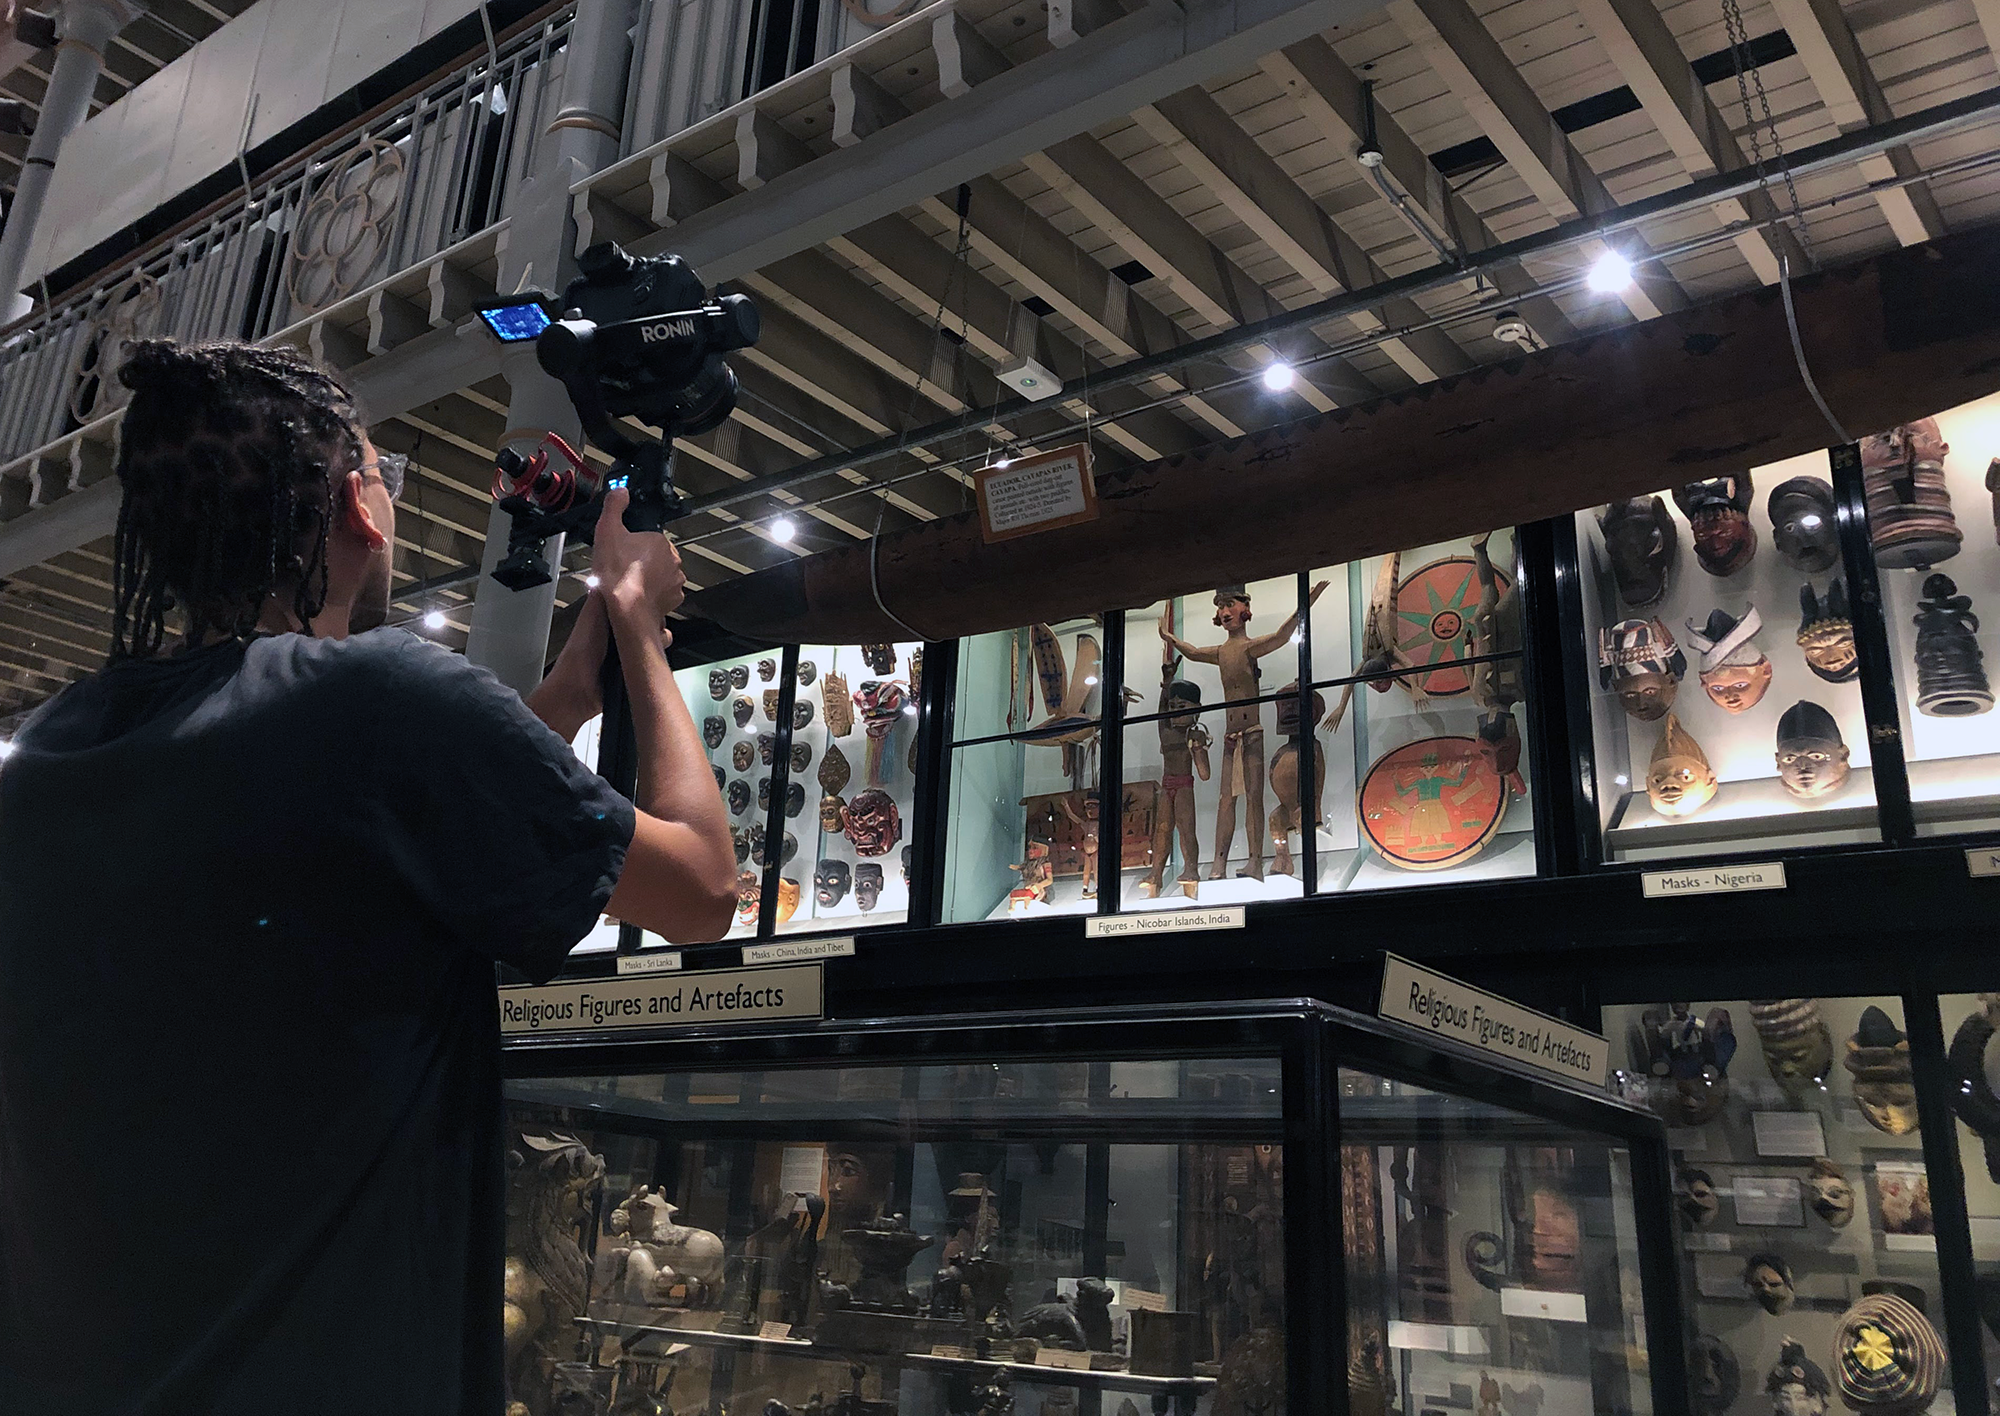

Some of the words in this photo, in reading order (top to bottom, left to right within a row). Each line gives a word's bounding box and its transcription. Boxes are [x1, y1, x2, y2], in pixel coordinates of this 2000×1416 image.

[641, 319, 696, 343] RONIN
[1661, 876, 1700, 890] Masks
[1714, 872, 1764, 888] Nigeria
[1098, 922, 1128, 934] Figures
[1136, 918, 1172, 929] Nicobar
[1174, 915, 1206, 926] Islands,
[1208, 913, 1230, 924] India
[752, 950, 770, 960] Masks
[796, 946, 812, 956] India
[813, 945, 826, 954] and
[826, 943, 844, 953] Tibet
[624, 960, 642, 970] Masks
[647, 960, 656, 968] Sri
[656, 958, 673, 968] Lanka
[502, 998, 574, 1028] Religious
[580, 994, 642, 1024] Figures
[648, 988, 682, 1014] and
[689, 983, 784, 1012] Artefacts
[1408, 981, 1468, 1028] Religious
[1472, 1005, 1514, 1044] Figures
[1518, 1029, 1540, 1054] and
[1542, 1032, 1591, 1072] Artefacts
